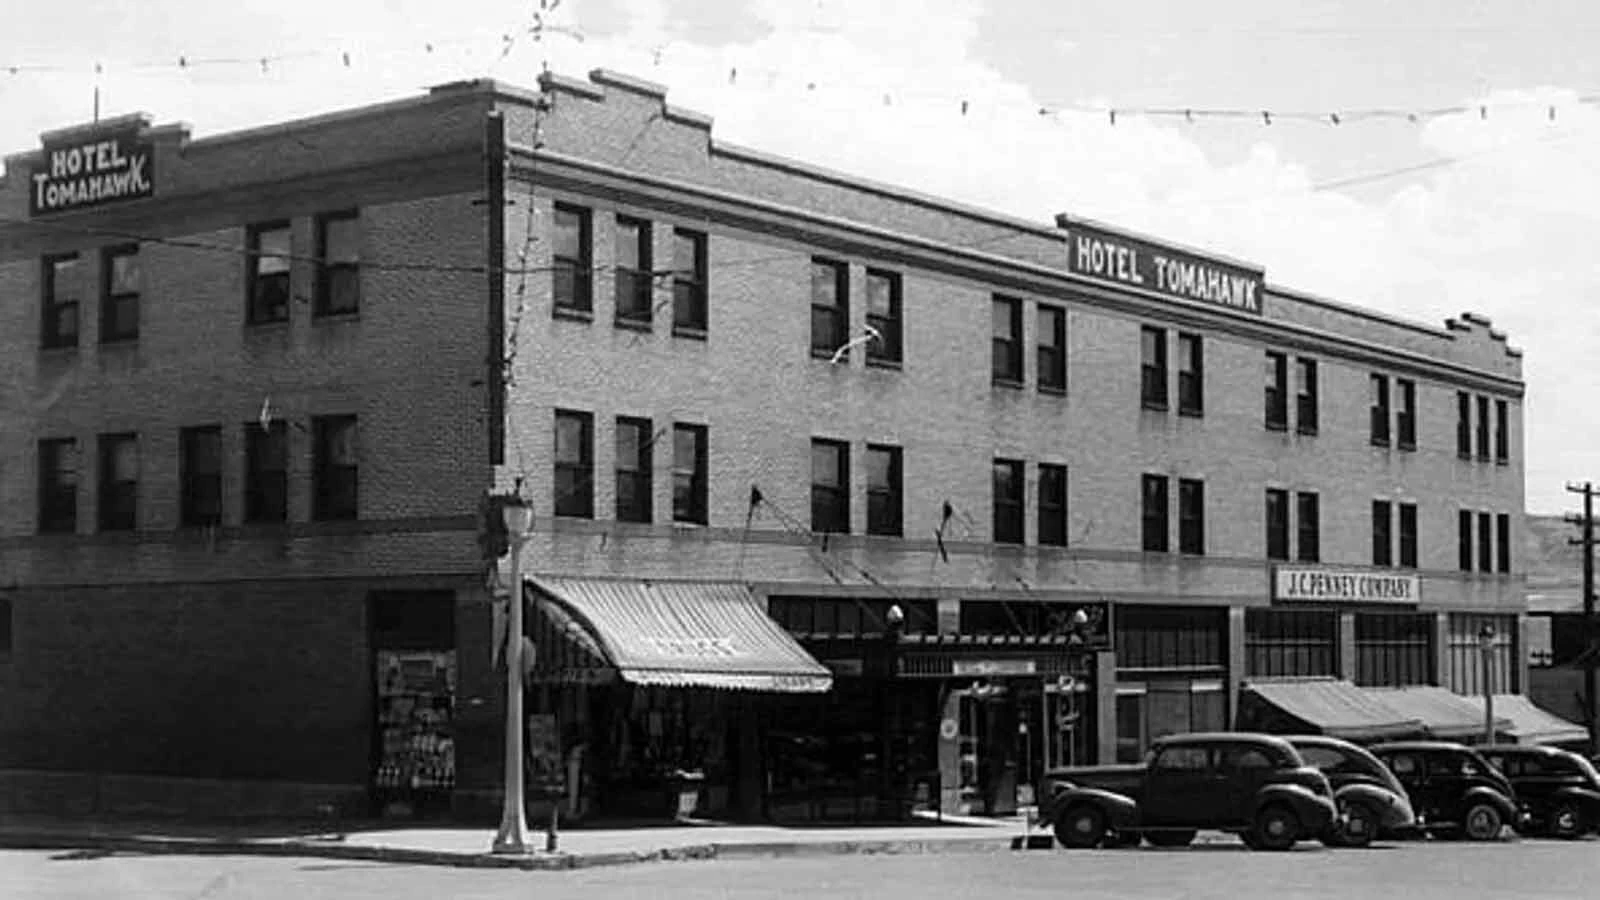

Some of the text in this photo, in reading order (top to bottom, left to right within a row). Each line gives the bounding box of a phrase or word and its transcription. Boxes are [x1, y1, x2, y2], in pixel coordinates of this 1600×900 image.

[51, 141, 128, 177] HOTEL
[1077, 236, 1258, 311] HOTEL TOMAHAWK
